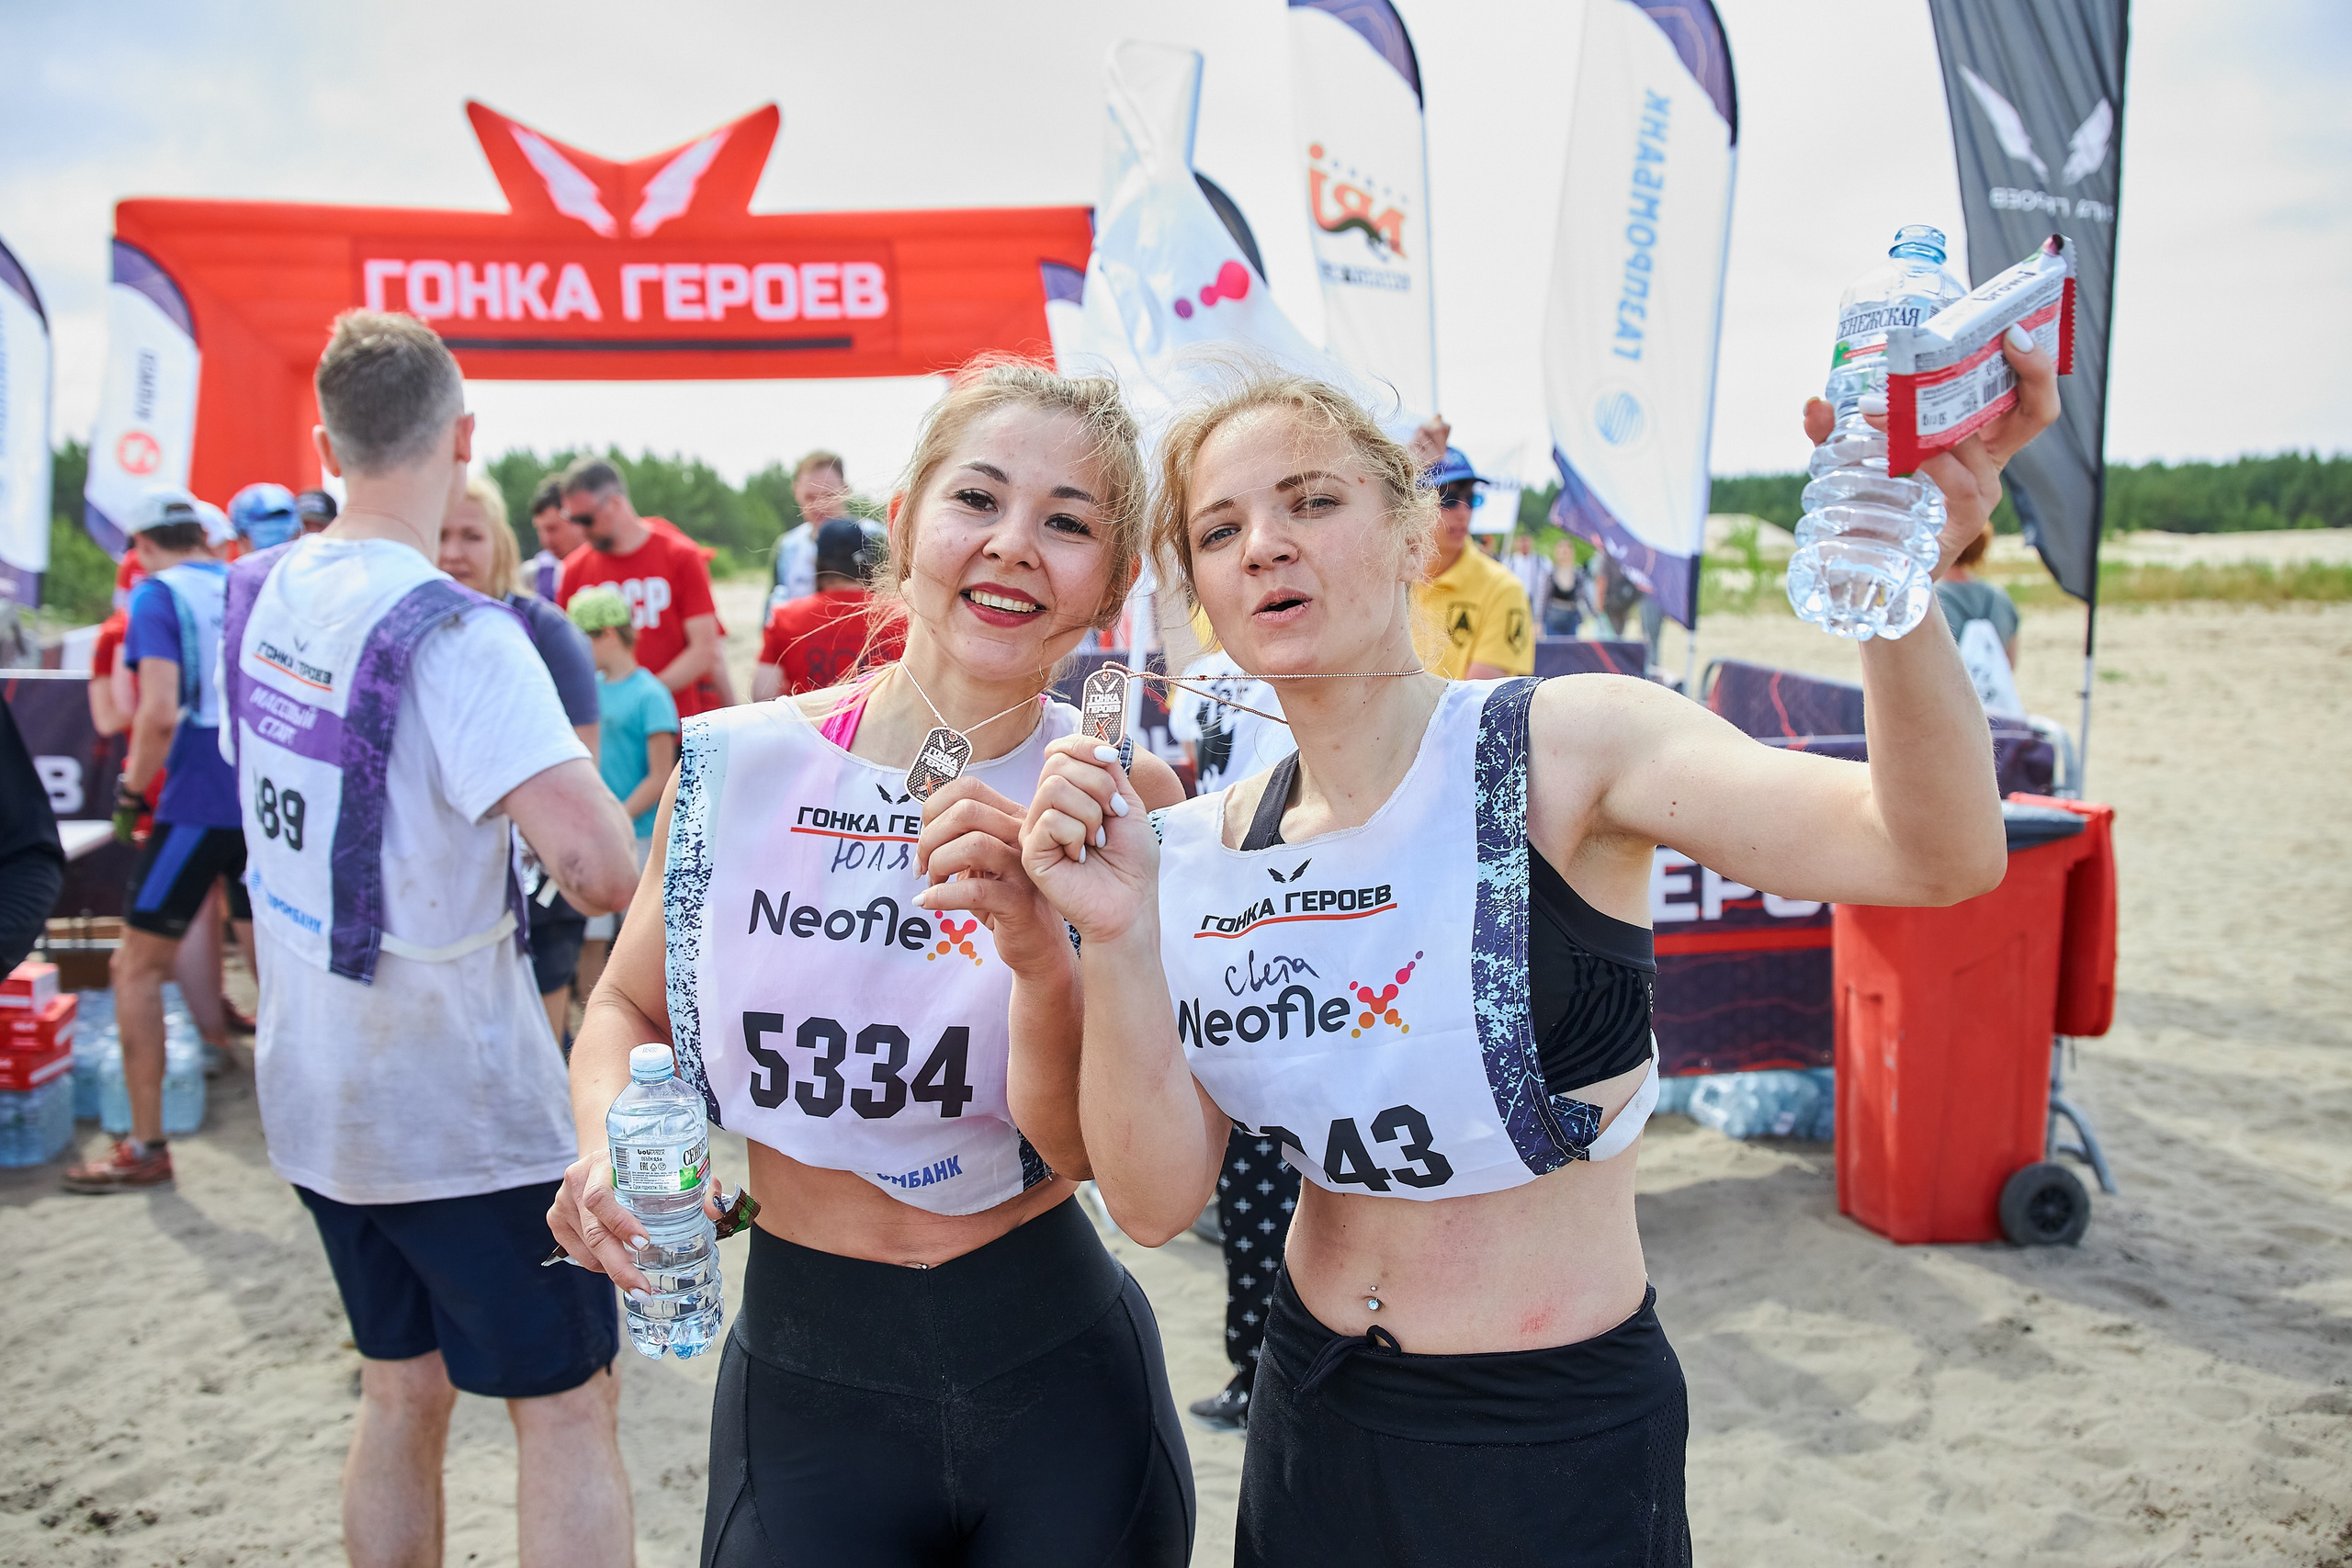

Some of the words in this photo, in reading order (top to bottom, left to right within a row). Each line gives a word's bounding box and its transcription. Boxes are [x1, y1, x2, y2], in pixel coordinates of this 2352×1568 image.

[364, 259, 603, 321] ГОНКА
[620, 261, 889, 321] ГЕРОЕВ
[576, 576, 672, 630] СР
[1086, 705, 1121, 714] ГЕРОЕВ
[797, 806, 879, 833] ГОНКА
[1201, 897, 1275, 932] ГОНКА
[1285, 884, 1392, 913] ГЕРОЕВ
[742, 1011, 973, 1119] 5334
